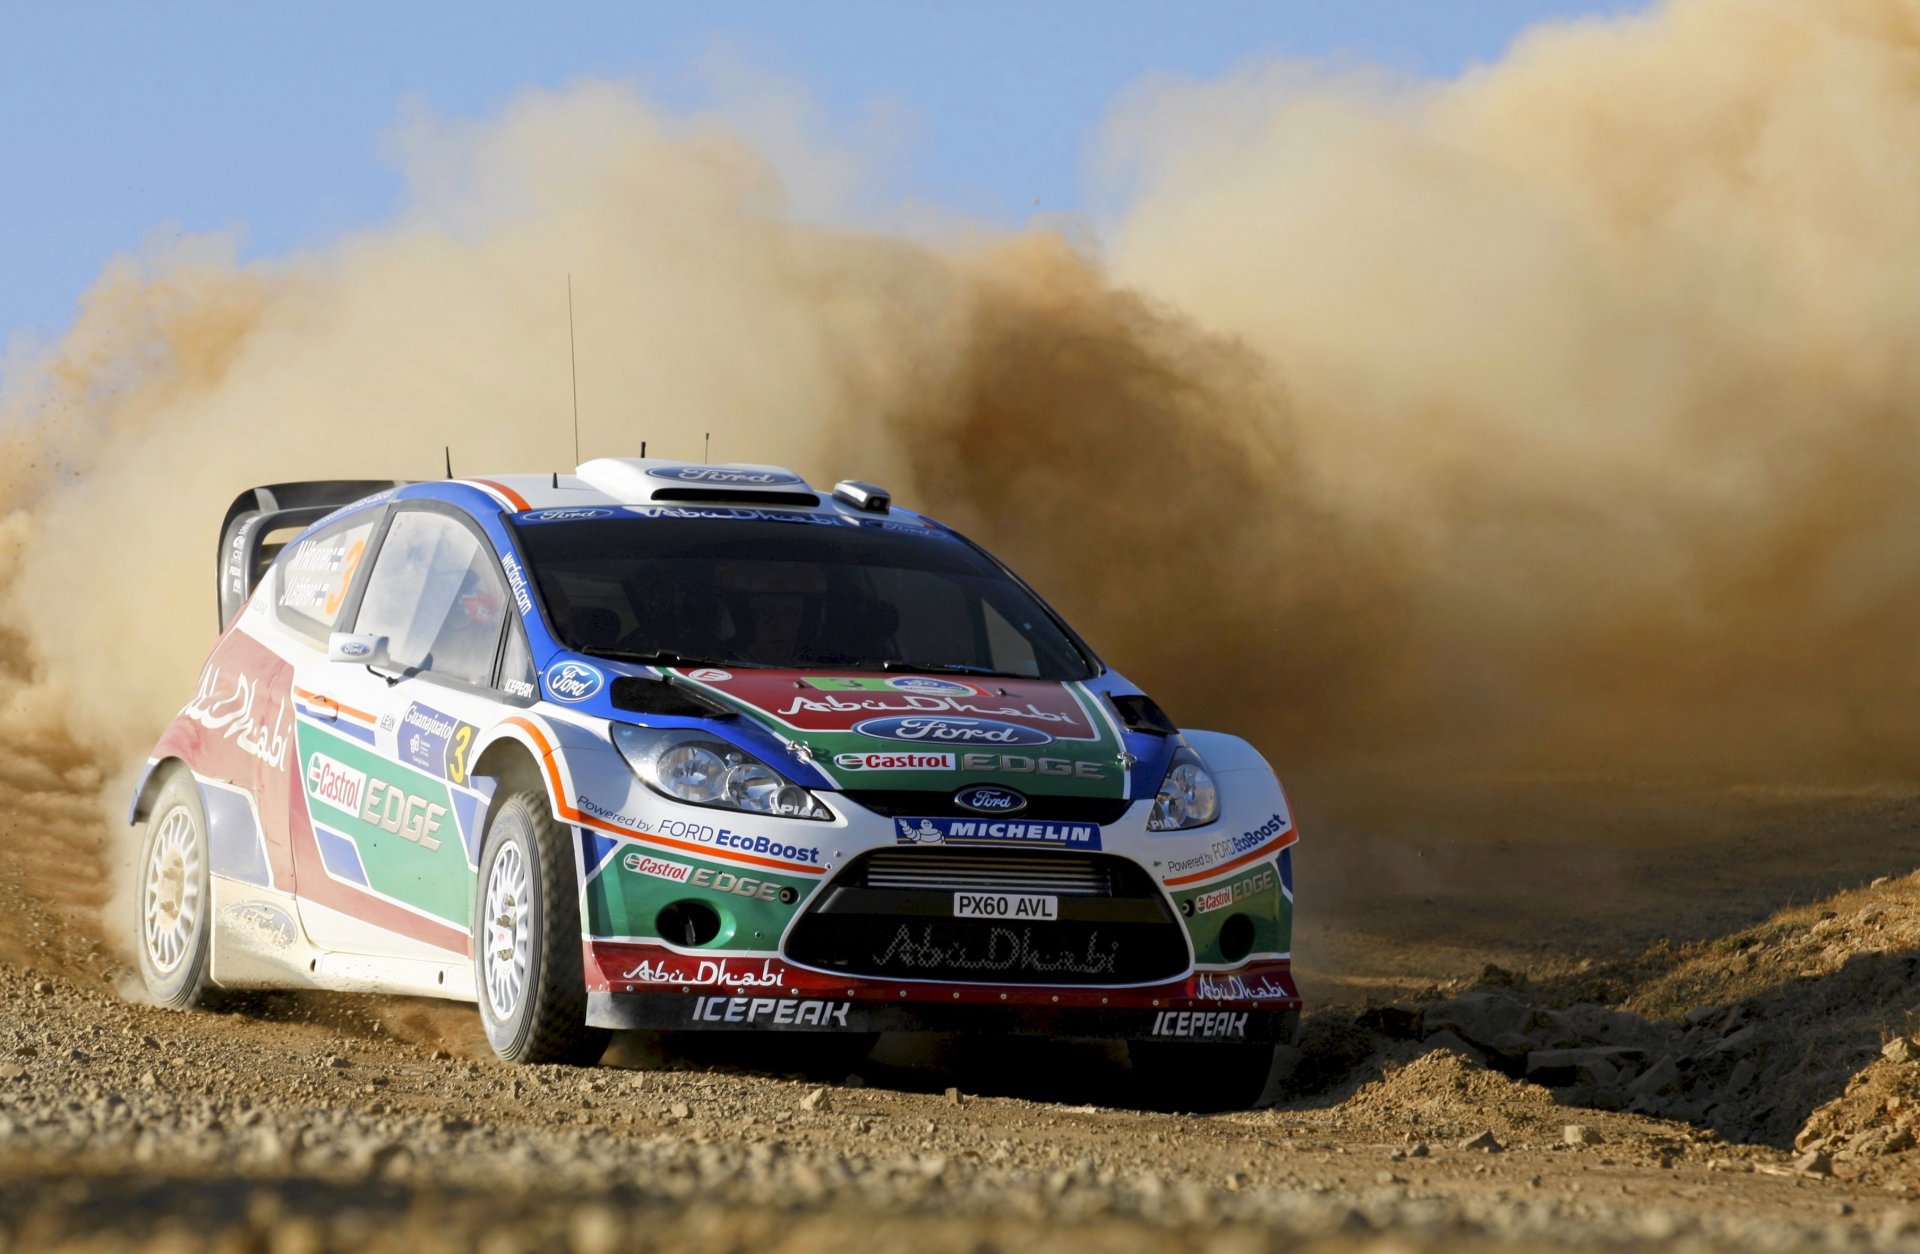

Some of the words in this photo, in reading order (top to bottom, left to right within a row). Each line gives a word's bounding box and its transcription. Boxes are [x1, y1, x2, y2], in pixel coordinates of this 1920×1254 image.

[678, 467, 775, 485] Ford
[540, 509, 598, 520] Ford
[324, 539, 364, 615] 3
[501, 552, 532, 616] wrcford.com
[552, 665, 594, 697] Ford
[404, 705, 452, 740] Guanajuato
[898, 716, 1019, 744] Ford
[449, 726, 472, 784] 3
[866, 753, 948, 769] Castrol
[961, 753, 1107, 780] EDGE
[319, 763, 361, 811] Castrol
[361, 778, 448, 852] EDGE
[780, 804, 826, 818] PIAA
[972, 790, 1011, 809] Ford
[577, 795, 635, 827] Powered
[637, 819, 654, 832] by
[658, 819, 713, 842] FORD
[716, 829, 819, 864] EcoBoost
[950, 822, 1091, 842] MICHELIN
[1168, 856, 1204, 873] Powered
[1205, 853, 1214, 864] by
[1212, 839, 1235, 860] FORD
[1232, 813, 1286, 852] EcoBoost
[638, 857, 688, 880] Castrol
[690, 868, 782, 902] EDGE
[1205, 887, 1231, 910] Castrol
[1232, 870, 1274, 900] EDGE
[959, 896, 1008, 916] PX60
[1015, 898, 1053, 917] AVL
[692, 996, 850, 1027] ICEPEAK
[1152, 1011, 1249, 1037] ICEPEAK
